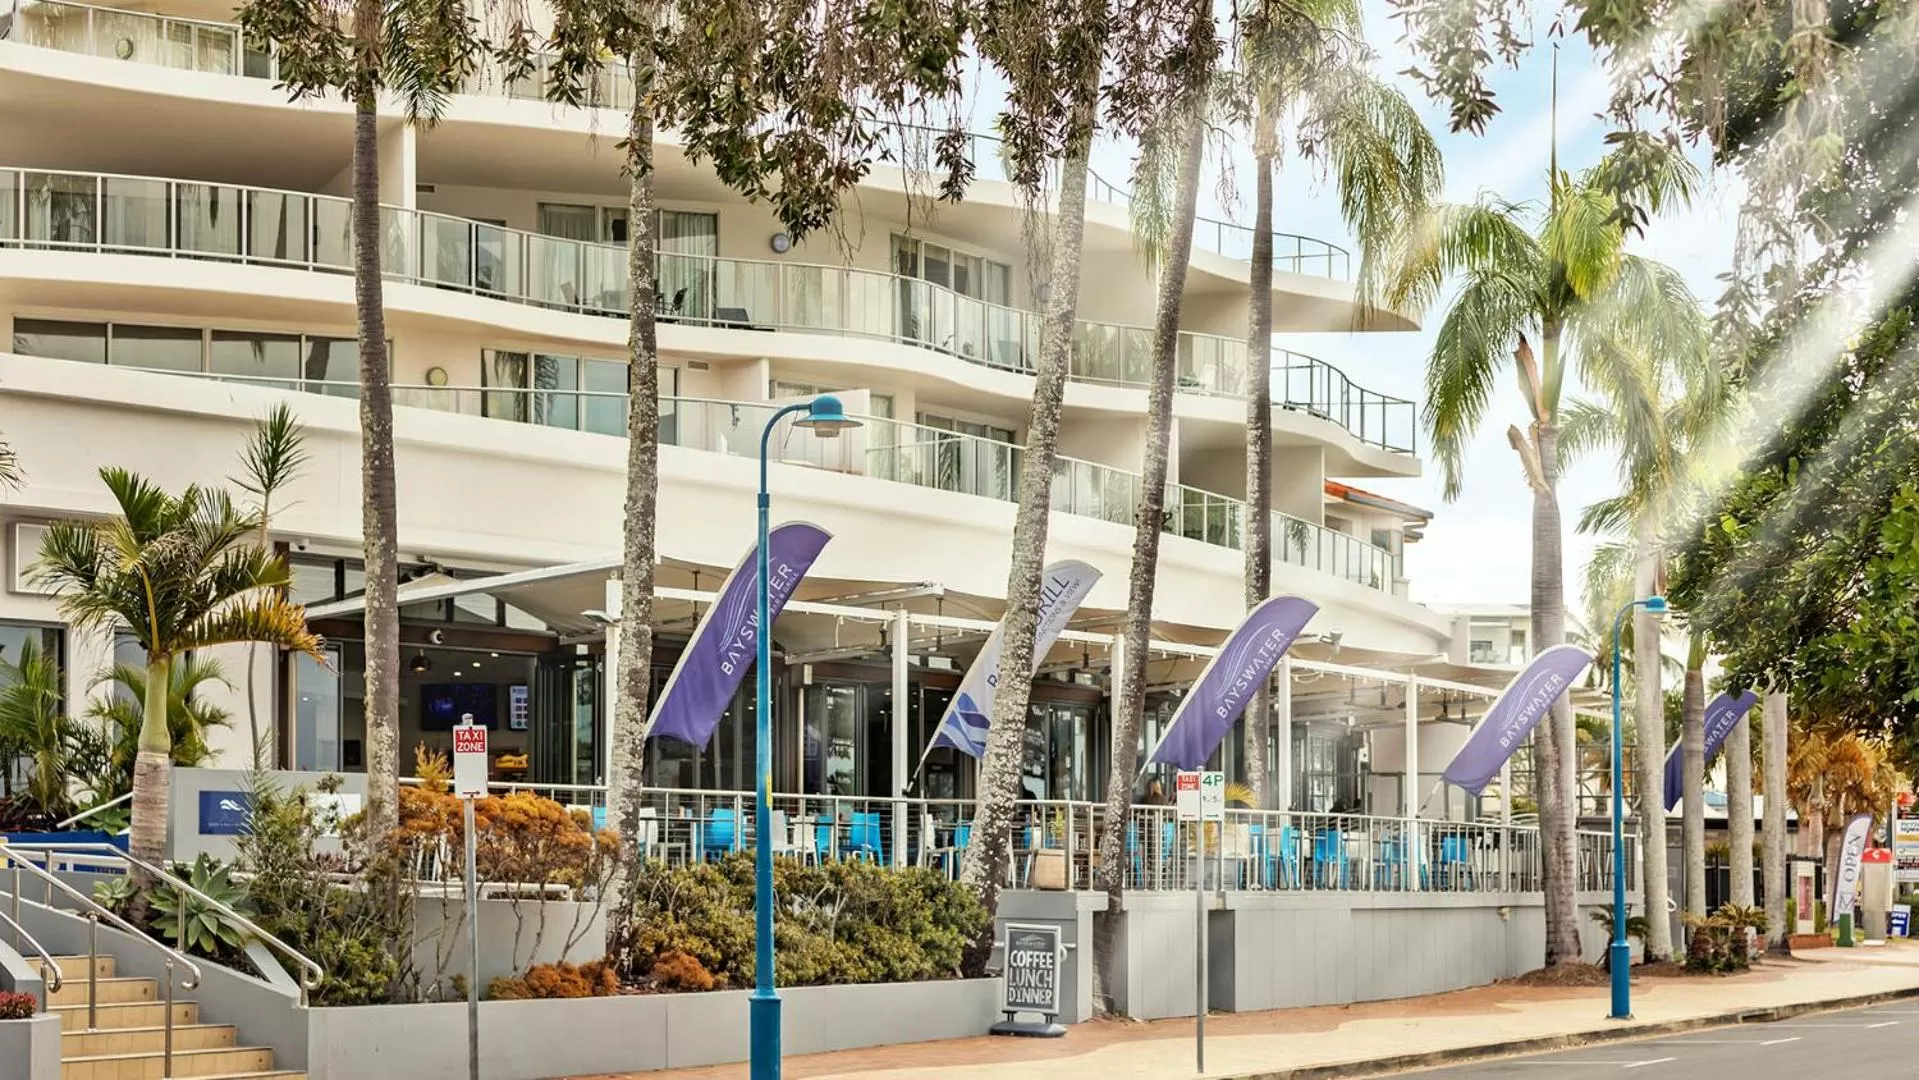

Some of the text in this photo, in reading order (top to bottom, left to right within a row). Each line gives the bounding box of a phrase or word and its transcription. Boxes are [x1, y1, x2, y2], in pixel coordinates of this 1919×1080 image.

[721, 563, 793, 675] BAYSWER
[1216, 628, 1285, 719] BAYSWATER
[1499, 673, 1563, 748] BAYSWATER
[458, 731, 483, 740] TAXI
[457, 742, 484, 752] ZONE
[1203, 775, 1223, 786] 4P
[1844, 834, 1862, 882] OPEN
[1010, 950, 1053, 969] COFFEE
[1009, 968, 1052, 989] LUNCH
[1009, 987, 1052, 1004] DINNER
